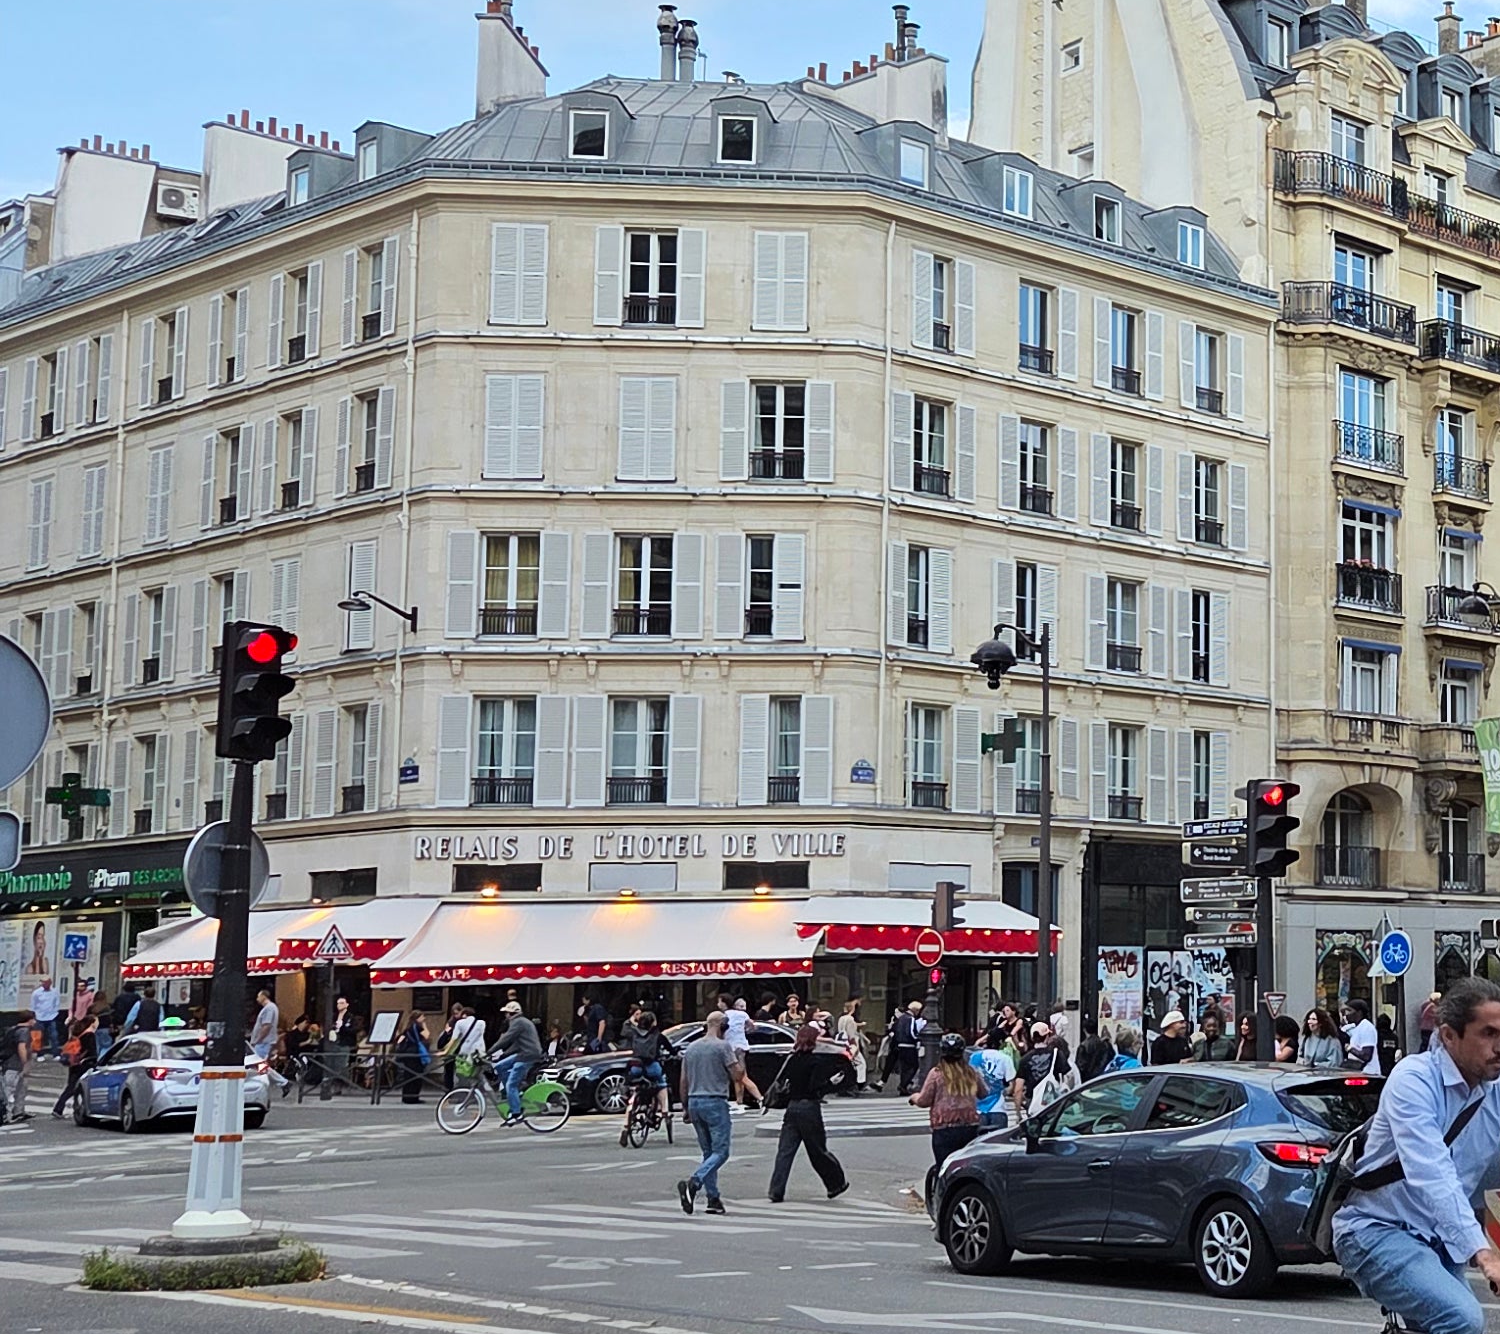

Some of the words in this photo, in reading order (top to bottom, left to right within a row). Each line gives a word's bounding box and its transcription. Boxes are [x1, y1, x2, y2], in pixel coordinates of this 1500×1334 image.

[1481, 748, 1500, 772] 10
[415, 835, 518, 860] RELAIS
[538, 835, 573, 860] DE
[594, 831, 706, 858] L'HOTEL
[722, 833, 756, 857] DE
[772, 832, 845, 857] VILLE
[0, 865, 72, 895] Pharmacie
[660, 961, 757, 974] RESTAURANT
